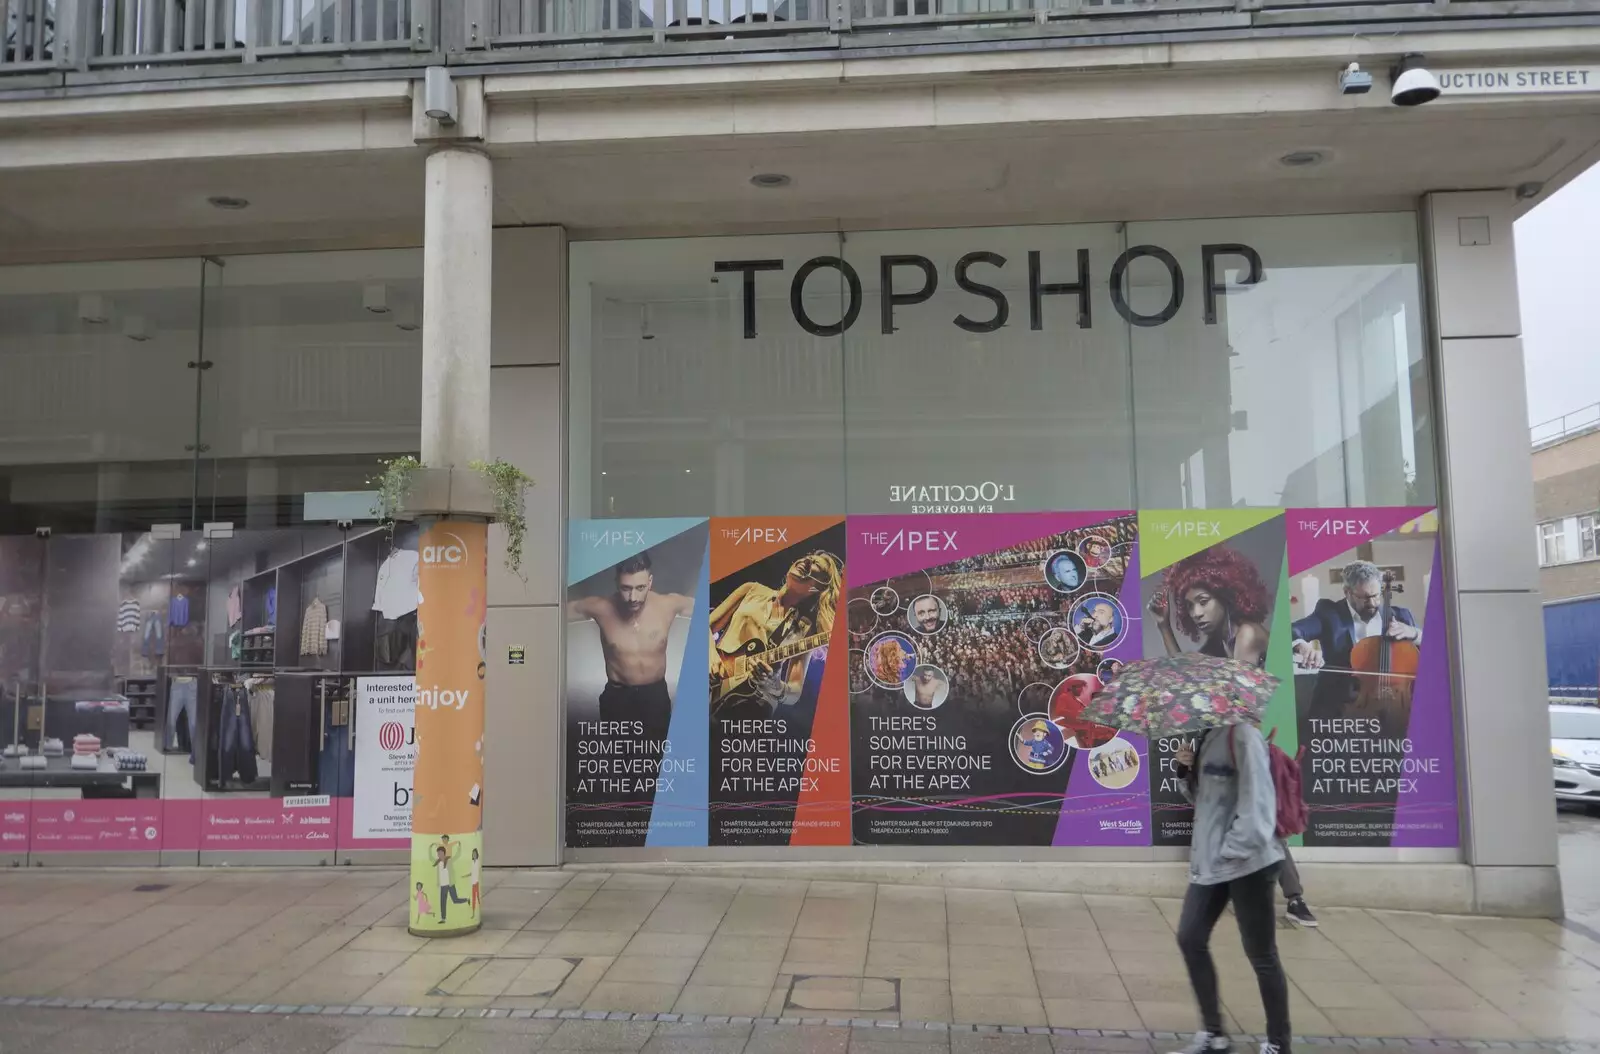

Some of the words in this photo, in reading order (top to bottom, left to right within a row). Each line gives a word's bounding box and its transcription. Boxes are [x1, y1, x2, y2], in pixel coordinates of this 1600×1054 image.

[1439, 72, 1509, 88] UCTION
[1516, 70, 1590, 86] STREET
[714, 243, 1266, 339] TOPSHOP
[720, 529, 740, 538] THE
[735, 527, 788, 545] APEX
[1151, 522, 1169, 532] THE
[1165, 520, 1221, 540] APEX
[1297, 521, 1318, 530] THE
[1313, 519, 1370, 538] APEX
[861, 532, 888, 545] THE
[881, 528, 958, 556] APEX
[423, 545, 461, 563] arc
[366, 683, 413, 692] Interested
[377, 695, 395, 704] unit
[416, 685, 469, 710] Enjoy
[577, 721, 644, 735] THERE'S
[720, 719, 787, 734] THERE'S
[869, 716, 937, 730] THERE'S
[1309, 718, 1381, 733] THERE'S
[578, 740, 672, 755] SOMETHING
[720, 738, 816, 753] SOMETHING
[869, 736, 967, 750] SOMETHING
[1310, 738, 1413, 753] SOMETHING
[578, 759, 609, 774] FOR
[613, 758, 696, 773] EVERYONE
[721, 758, 752, 772] FOR
[757, 758, 840, 772] EVERYONE
[870, 755, 902, 769] FOR
[906, 755, 991, 769] EVERYONE
[1160, 758, 1177, 772] FO
[1312, 758, 1346, 773] FOR
[1350, 758, 1440, 773] EVERYONE
[577, 778, 596, 792] AT
[599, 778, 630, 792] THE
[633, 778, 674, 792] APEX
[720, 777, 740, 791] AT
[743, 777, 774, 791] THE
[778, 777, 819, 791] APEX
[869, 775, 890, 789] AT
[893, 775, 924, 789] THE
[928, 775, 970, 789] APEX
[1160, 778, 1178, 792] AT
[1312, 778, 1333, 793] AT
[1336, 778, 1371, 793] THE
[1374, 778, 1418, 793] APEX
